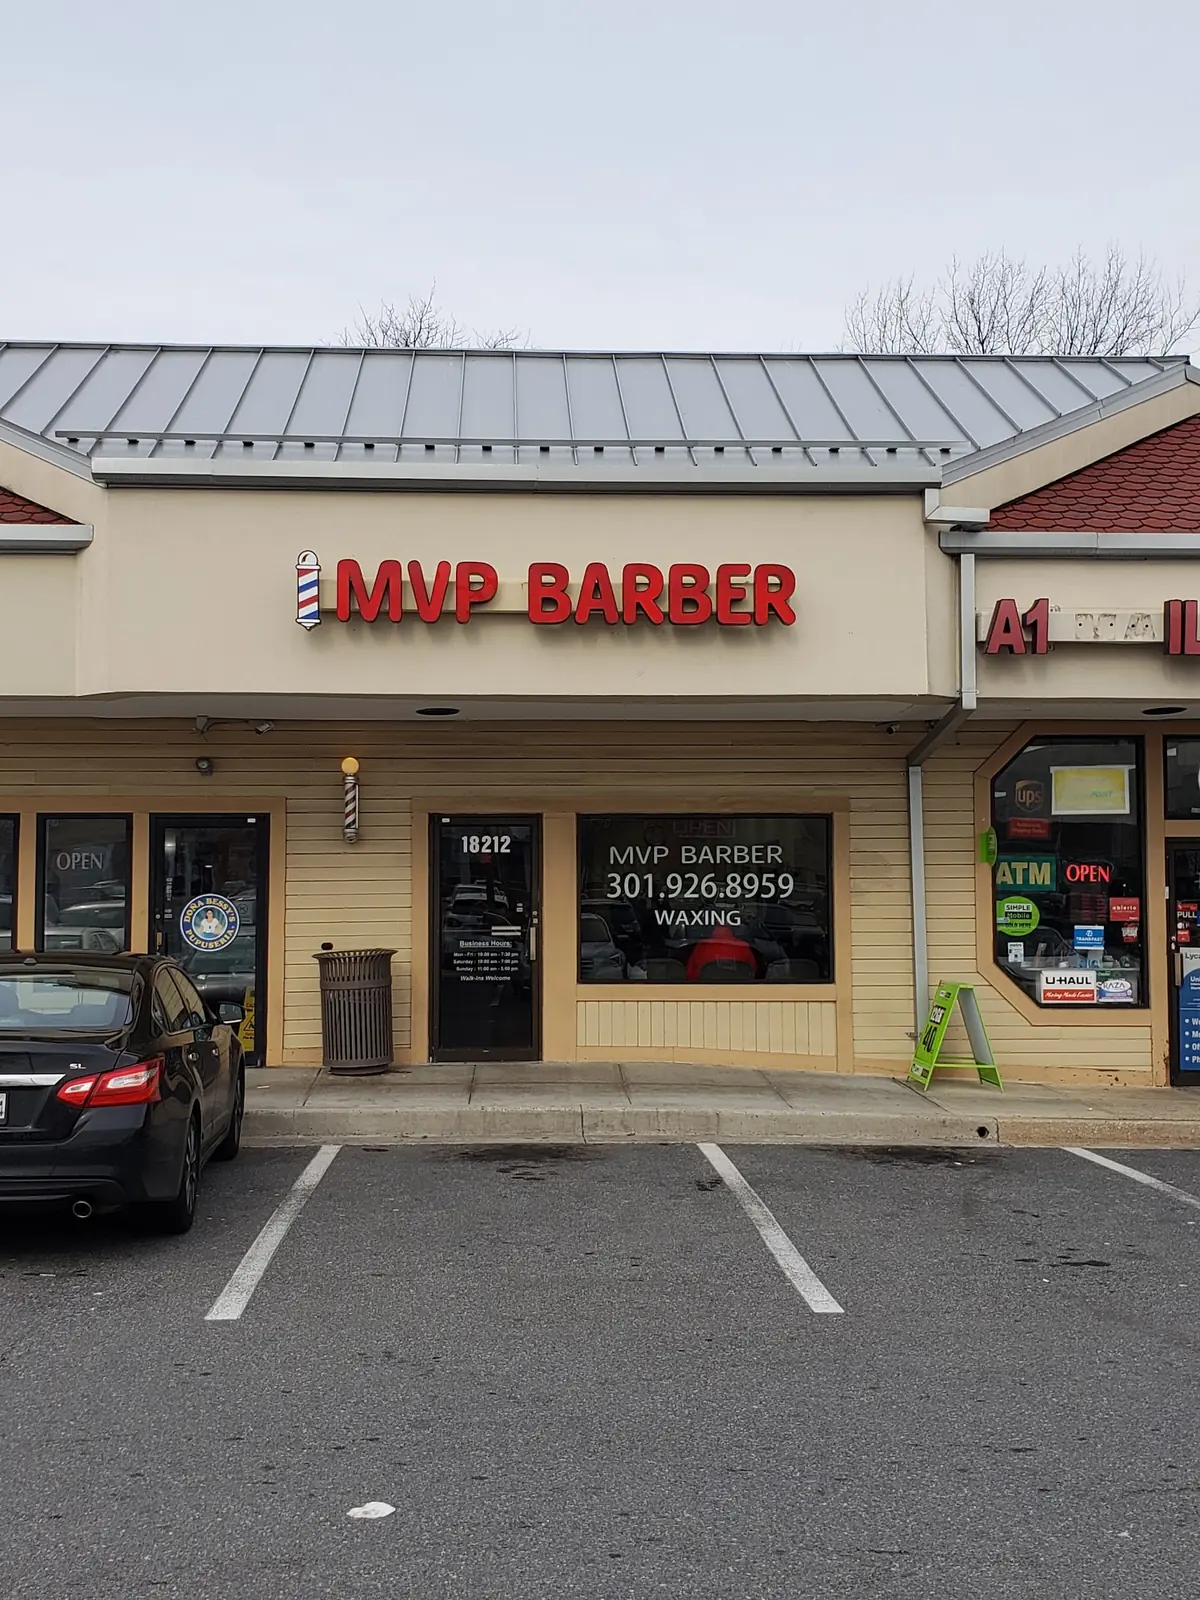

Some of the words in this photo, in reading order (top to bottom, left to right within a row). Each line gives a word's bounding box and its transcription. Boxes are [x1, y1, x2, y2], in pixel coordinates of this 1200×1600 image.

[336, 559, 498, 623] MVP
[527, 562, 797, 627] BARBER
[984, 598, 1050, 655] A1
[1018, 790, 1043, 808] ups
[461, 835, 511, 854] 18212
[56, 852, 104, 870] OPEN
[609, 846, 669, 865] MVP
[681, 845, 783, 864] BARBER
[995, 862, 1051, 885] ATM
[1066, 864, 1110, 882] OPEN
[606, 873, 794, 899] 301.926.8959
[654, 909, 741, 926] WAXING
[186, 929, 234, 949] PUPUSERIA
[460, 940, 489, 948] Business
[1045, 976, 1092, 985] U-HAUL
[1045, 990, 1063, 999] Moving
